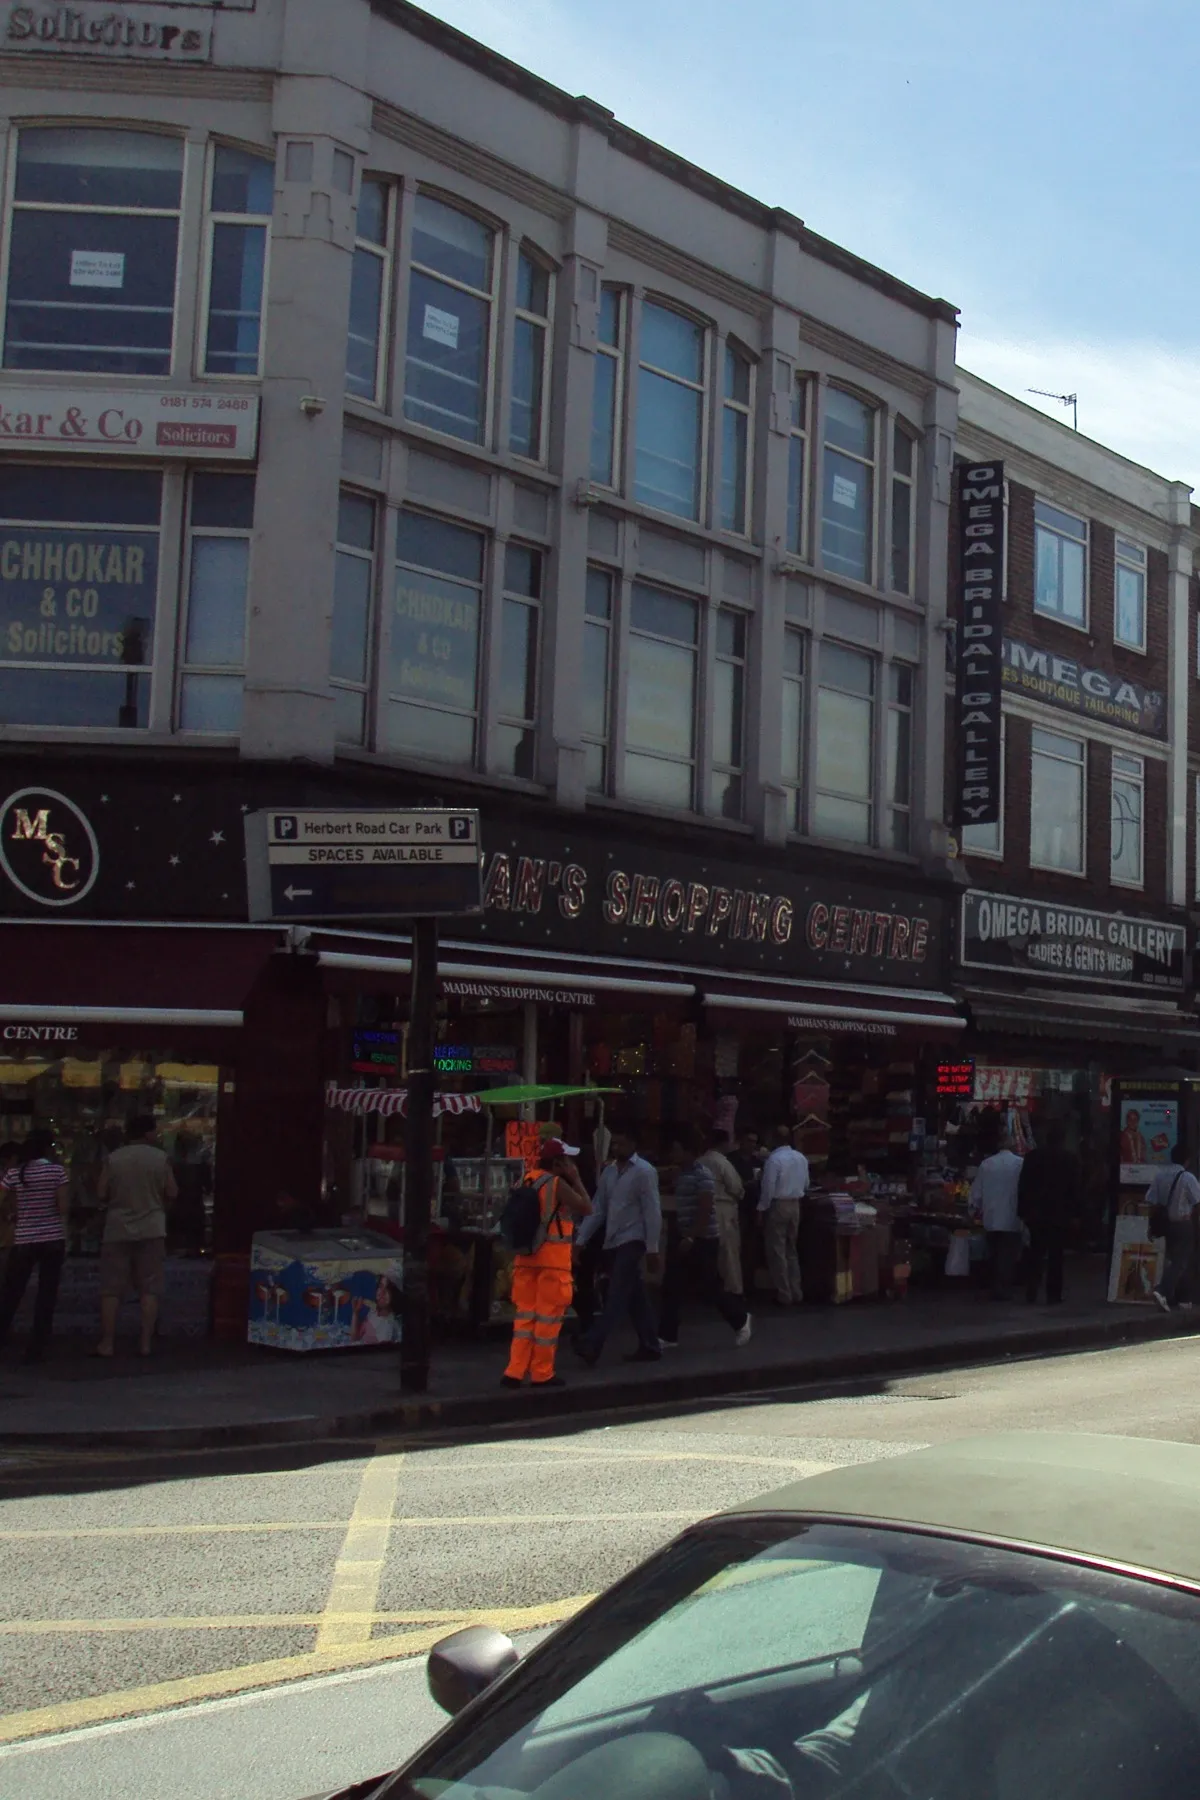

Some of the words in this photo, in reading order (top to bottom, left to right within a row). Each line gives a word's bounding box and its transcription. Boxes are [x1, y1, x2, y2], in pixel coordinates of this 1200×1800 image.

[7, 7, 201, 50] Solicitors
[160, 396, 187, 408] 0181
[191, 397, 212, 409] 574
[59, 407, 88, 437] &
[98, 409, 143, 439] Co
[162, 427, 231, 445] Solicitors
[962, 468, 1000, 556] OMEGA
[1, 540, 145, 584] CHHOKAR
[40, 587, 57, 617] &
[66, 588, 99, 618] CO
[962, 567, 994, 675] BRIDAL
[8, 621, 126, 657] Solicitors
[1001, 643, 1141, 710] MEGA
[1022, 675, 1080, 706] BOUTIQUE
[1084, 695, 1139, 725] TAILORING
[961, 691, 993, 819] GALLERY
[304, 822, 352, 834] Herbert
[356, 822, 385, 834] Road
[389, 822, 409, 834] Car
[416, 822, 442, 835] Park
[309, 849, 364, 861] SPACES
[373, 849, 443, 861] AVAILABLE
[481, 852, 587, 918] AN'S
[602, 870, 793, 944] SHOPPING
[805, 901, 929, 963] CENTRE
[978, 899, 1041, 942] OMEGA
[1046, 912, 1104, 940] BRIDAL
[1107, 922, 1176, 967] GALLERY
[1028, 943, 1063, 968] LADIES
[1065, 946, 1072, 968] &
[1074, 946, 1106, 973] GENTS
[1107, 953, 1133, 973] WEAR
[442, 981, 500, 997] MADHAN'S
[501, 986, 554, 1002] SHOPPING
[555, 991, 596, 1005] CENTRE
[3, 1025, 79, 1040] CENTRE
[788, 1016, 828, 1030] MADHAN'S
[828, 1020, 868, 1033] SHOPPING
[867, 1023, 897, 1036] CENTRE
